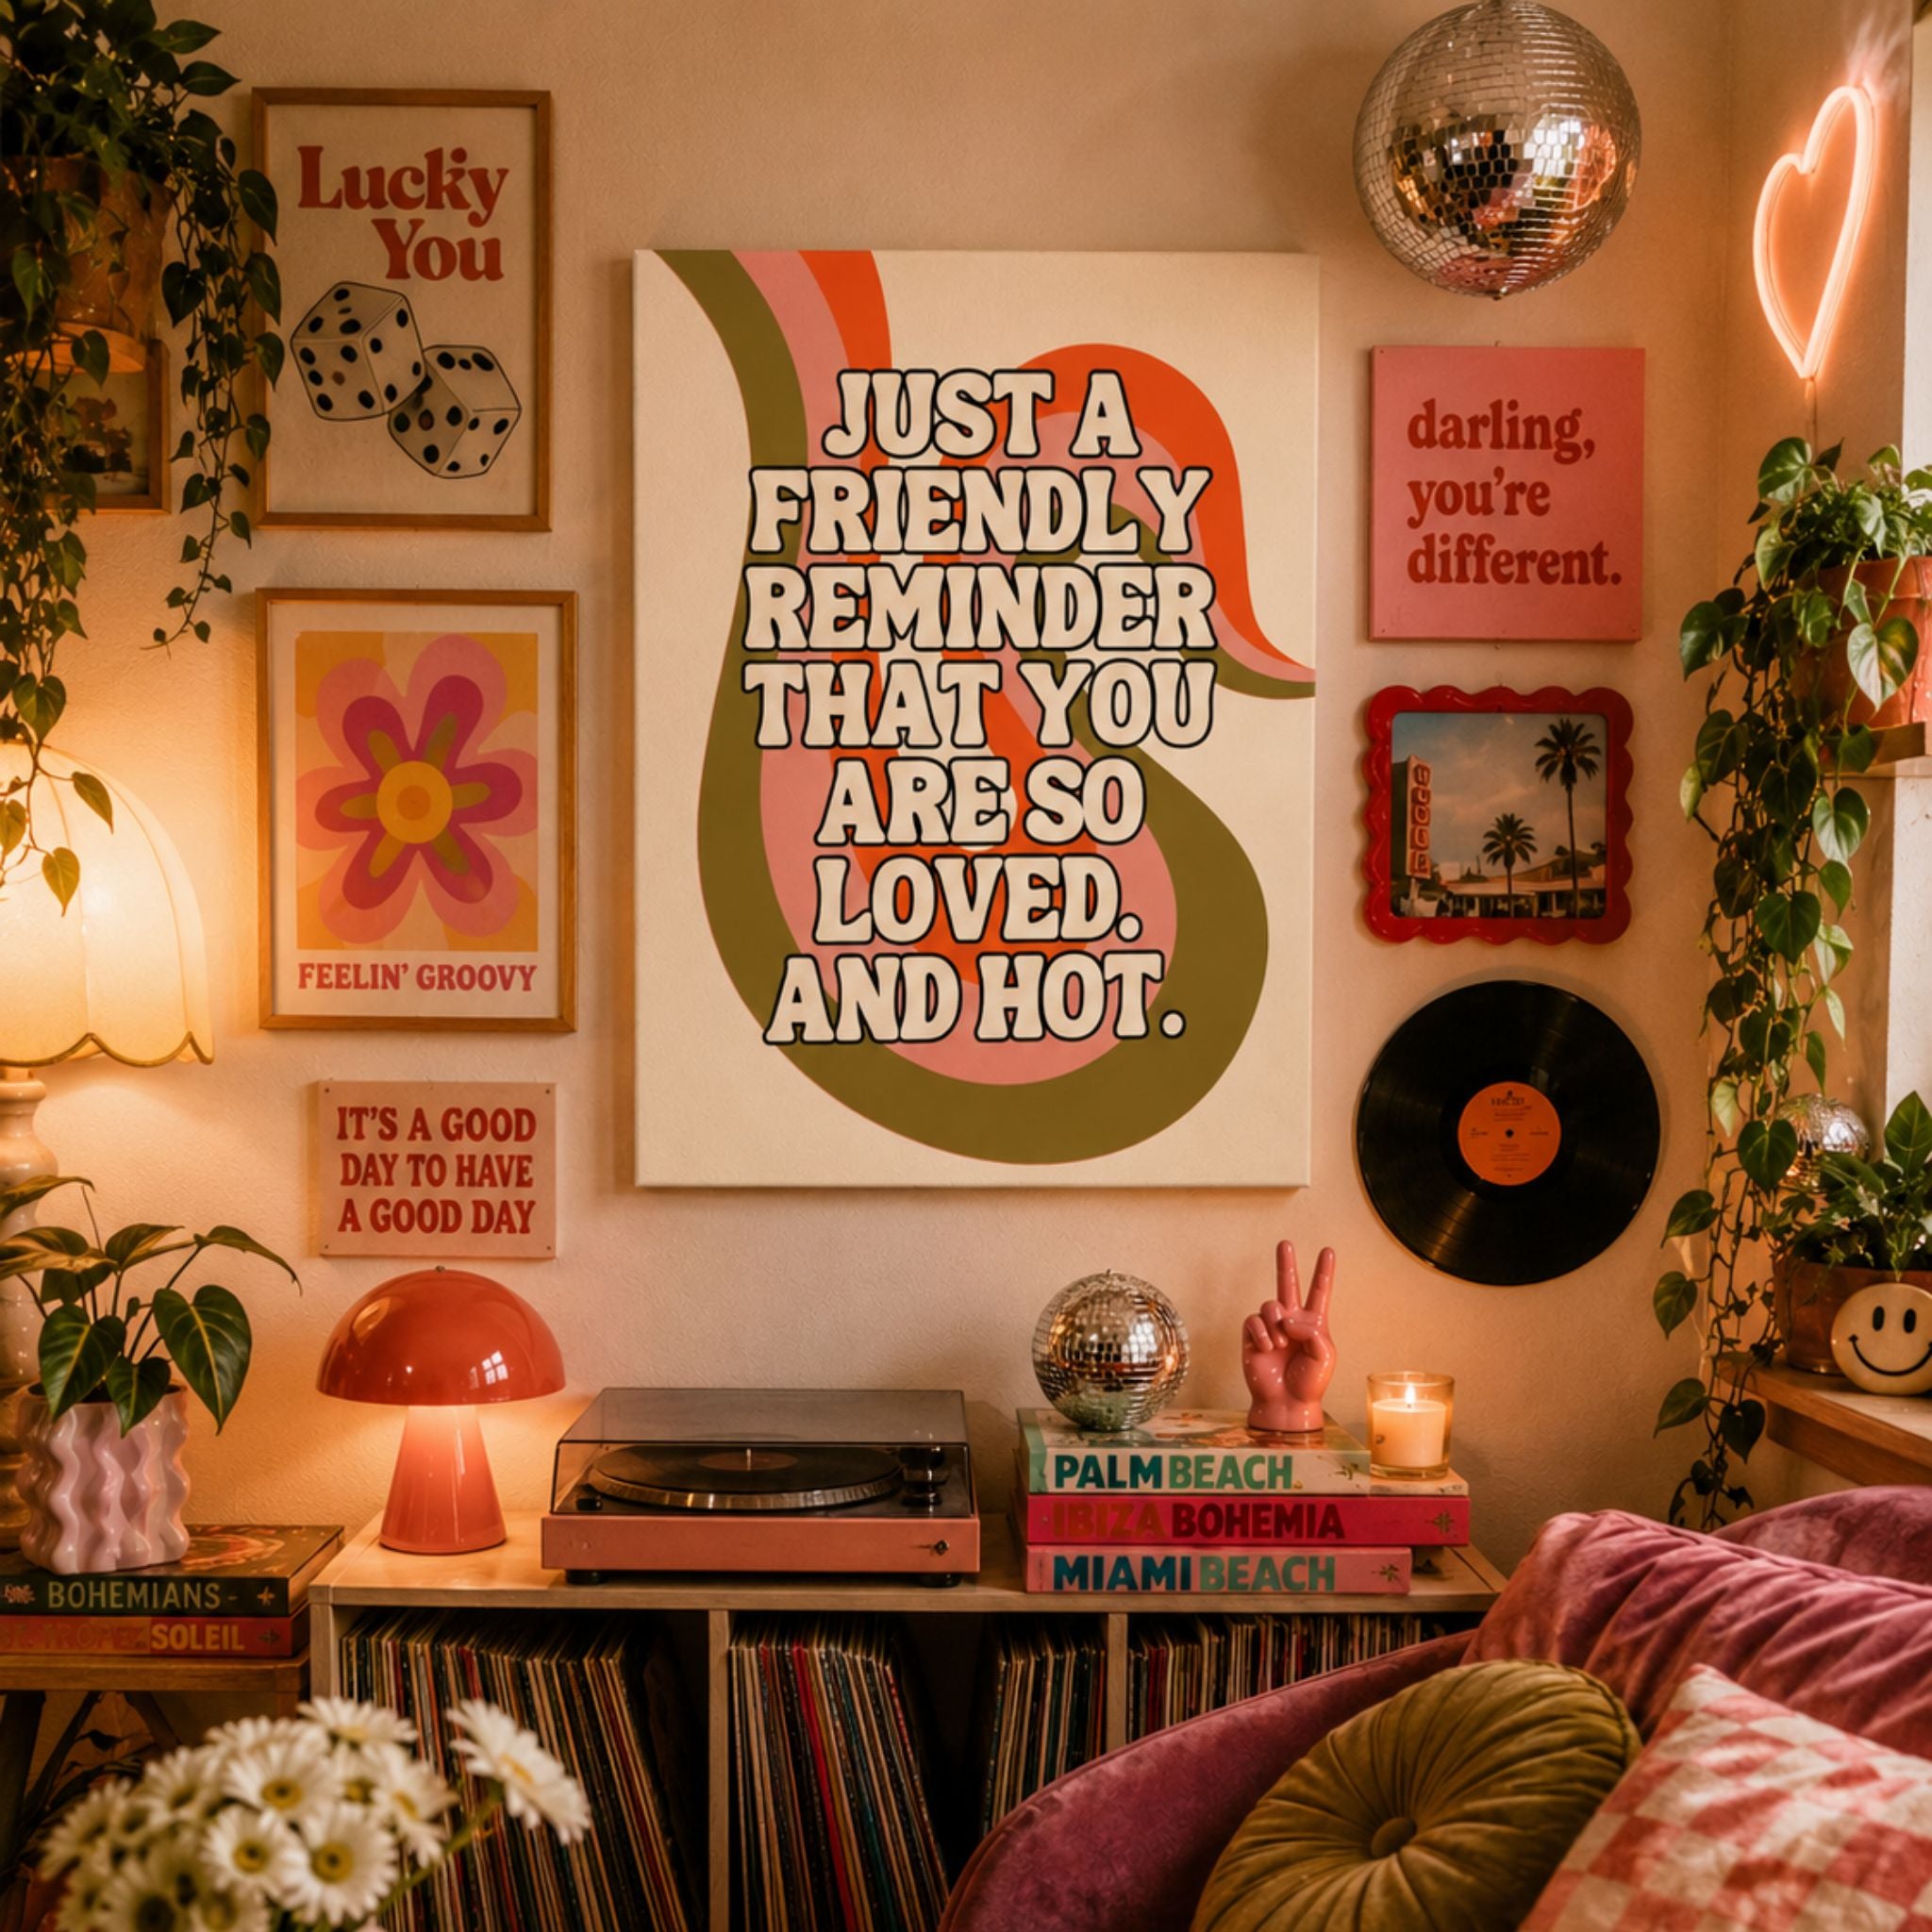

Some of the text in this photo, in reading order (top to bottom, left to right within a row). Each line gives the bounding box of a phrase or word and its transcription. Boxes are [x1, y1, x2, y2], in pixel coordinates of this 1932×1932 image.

[297, 145, 509, 227] Lucky
[371, 218, 505, 281] You
[821, 368, 1142, 458] JUST A
[1407, 397, 1595, 465] darling,
[748, 466, 1213, 555] FRIENDLY
[1407, 466, 1551, 529] you're
[1407, 532, 1622, 586] different.
[741, 563, 1218, 651] REMINDER
[741, 658, 1218, 749] THAT YOU
[814, 756, 1146, 846] ARE SO
[812, 854, 1143, 944] LOVED.
[298, 962, 538, 991] FEELIN' GROOVY
[762, 949, 1187, 1044] AND HOT.
[337, 1107, 537, 1142] IT'S A GOOD
[341, 1153, 533, 1188] DAY TO HAVE
[337, 1198, 537, 1234] A GOOD DAY
[1054, 1454, 1293, 1490] PALM BEACH
[1052, 1502, 1345, 1541] IBIZA BOHEMIA
[49, 1581, 222, 1609] BOHEMIANS
[1052, 1555, 1336, 1591] MIAMI BEACH
[151, 1624, 245, 1651] SOLEIL
